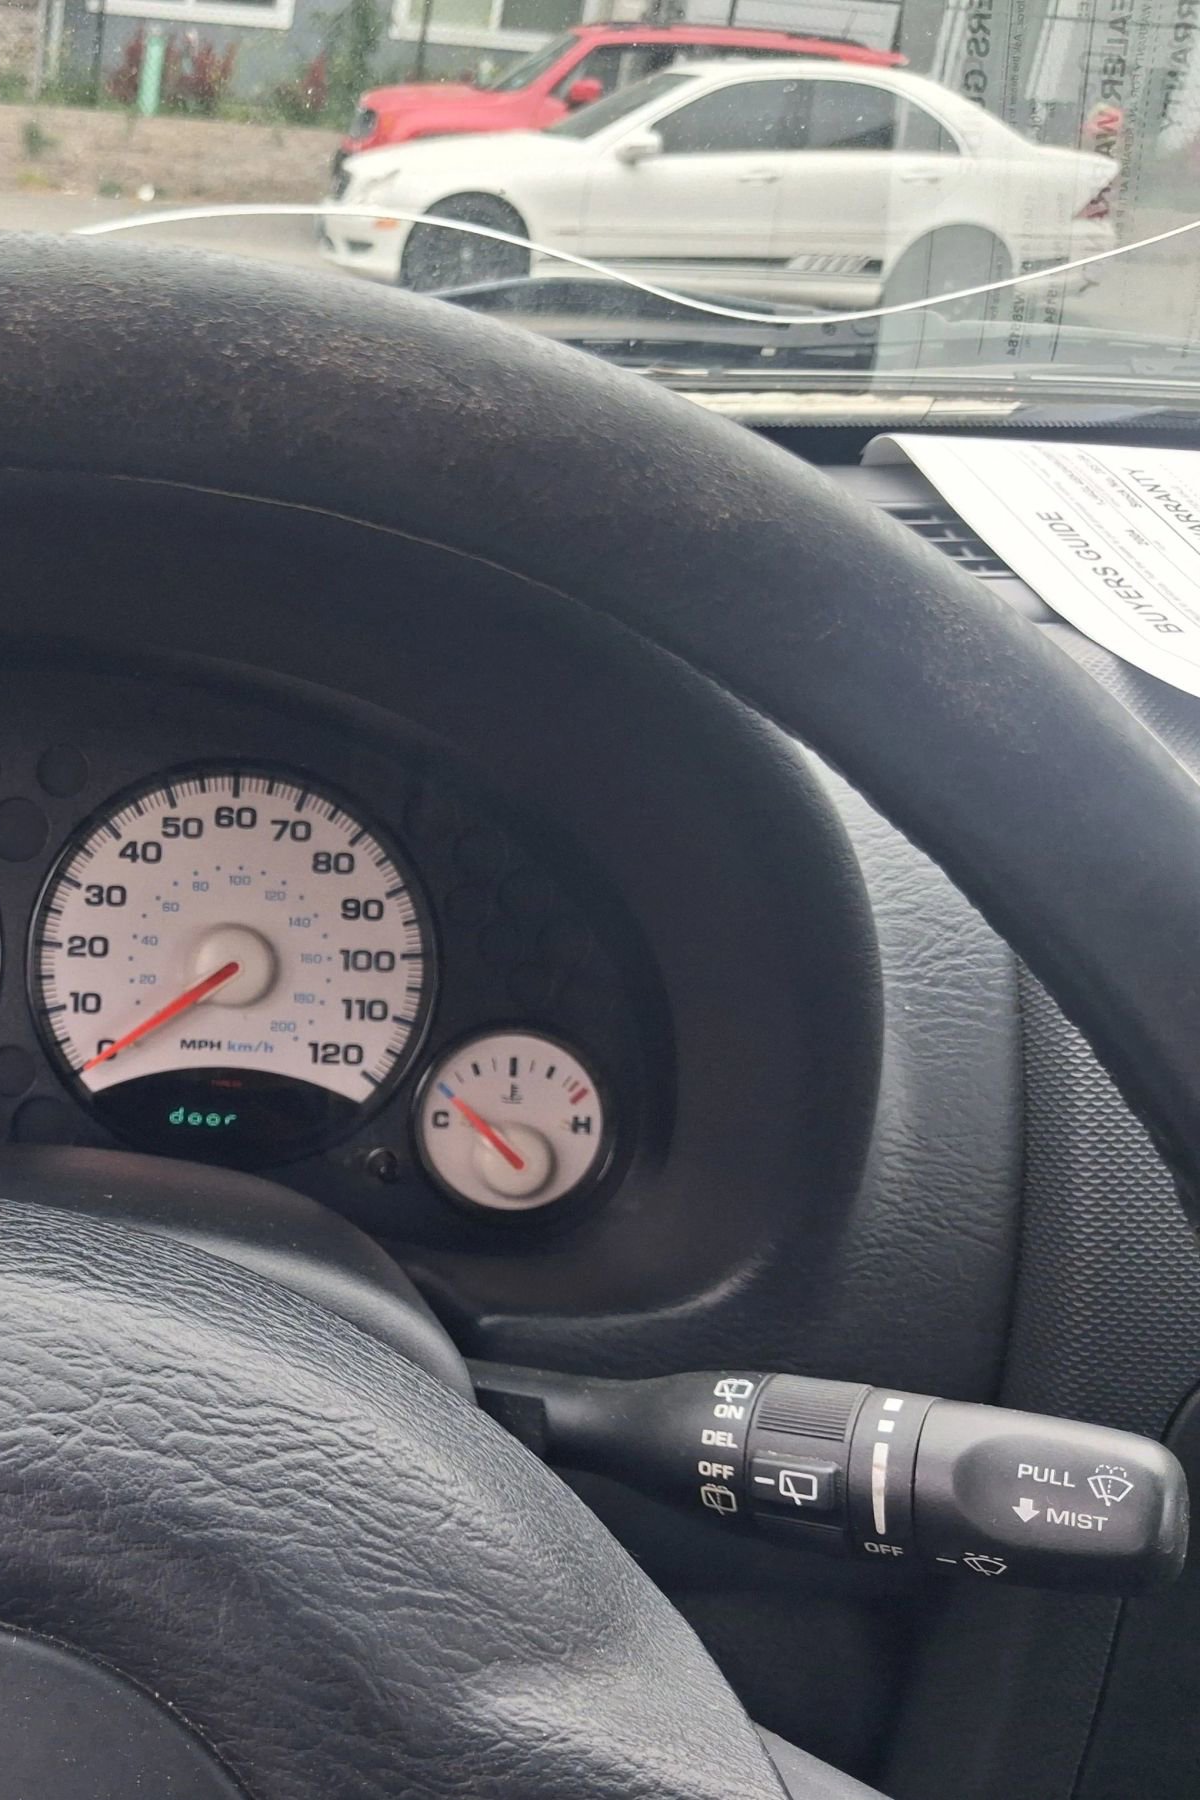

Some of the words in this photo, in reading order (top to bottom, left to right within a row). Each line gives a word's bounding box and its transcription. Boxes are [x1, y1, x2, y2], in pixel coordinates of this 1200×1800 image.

[1122, 467, 1200, 541] ARRANTY
[1036, 511, 1102, 561] GUIDE
[1092, 566, 1184, 633] BUYERS
[162, 817, 204, 839] 50
[214, 807, 258, 829] 60
[271, 820, 312, 842] 70
[119, 841, 162, 863] 40
[312, 852, 355, 875] 80
[192, 880, 210, 892] 80
[229, 875, 252, 886] 100
[84, 885, 127, 907] 30
[264, 890, 286, 901] 120
[162, 902, 180, 913] 60
[341, 899, 384, 921] 90
[67, 936, 109, 959] 20
[141, 935, 159, 947] 40
[339, 950, 395, 972] 100
[139, 974, 157, 985] 20
[69, 992, 102, 1014] 10
[342, 999, 388, 1021] 110
[270, 1021, 296, 1033] 200
[180, 1039, 222, 1051] MPH
[227, 1039, 274, 1053] km/h
[308, 1042, 364, 1065] 120
[169, 1107, 238, 1127] door
[432, 1111, 450, 1129] C
[572, 1116, 591, 1134] H
[714, 1403, 745, 1420] ON
[701, 1429, 738, 1449] DEL
[698, 1461, 735, 1480] OFF
[1017, 1463, 1075, 1488] PULL
[1046, 1508, 1108, 1532] MIST
[864, 1541, 904, 1557] OFF
